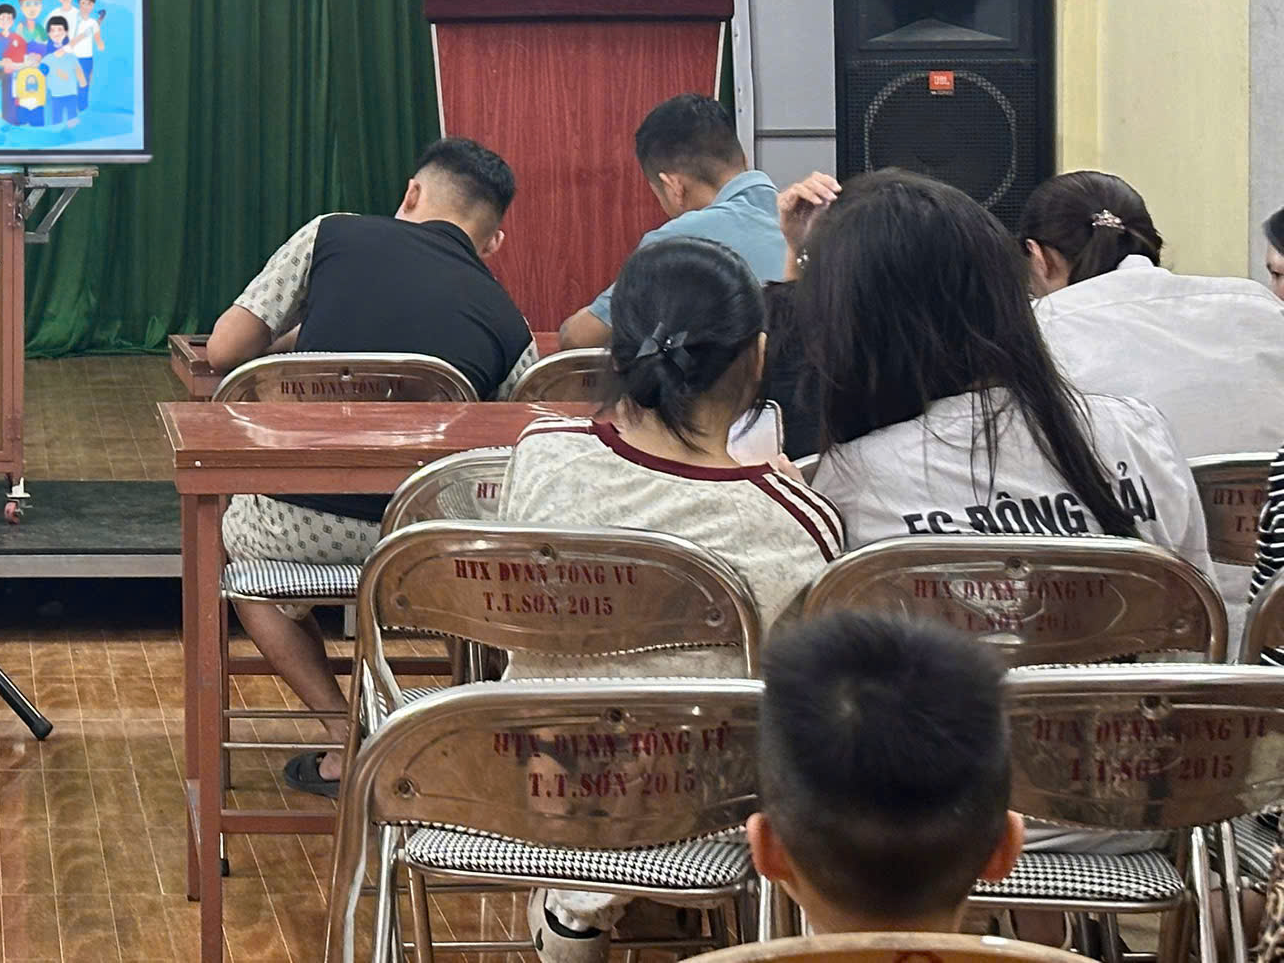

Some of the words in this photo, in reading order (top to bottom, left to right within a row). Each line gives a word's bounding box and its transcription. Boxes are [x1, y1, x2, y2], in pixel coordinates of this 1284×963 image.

[964, 490, 1089, 537] ĐÔNG
[454, 558, 492, 581] HTX
[568, 595, 614, 616] 2015
[1178, 755, 1234, 780] 2015
[642, 768, 696, 795] 2015
